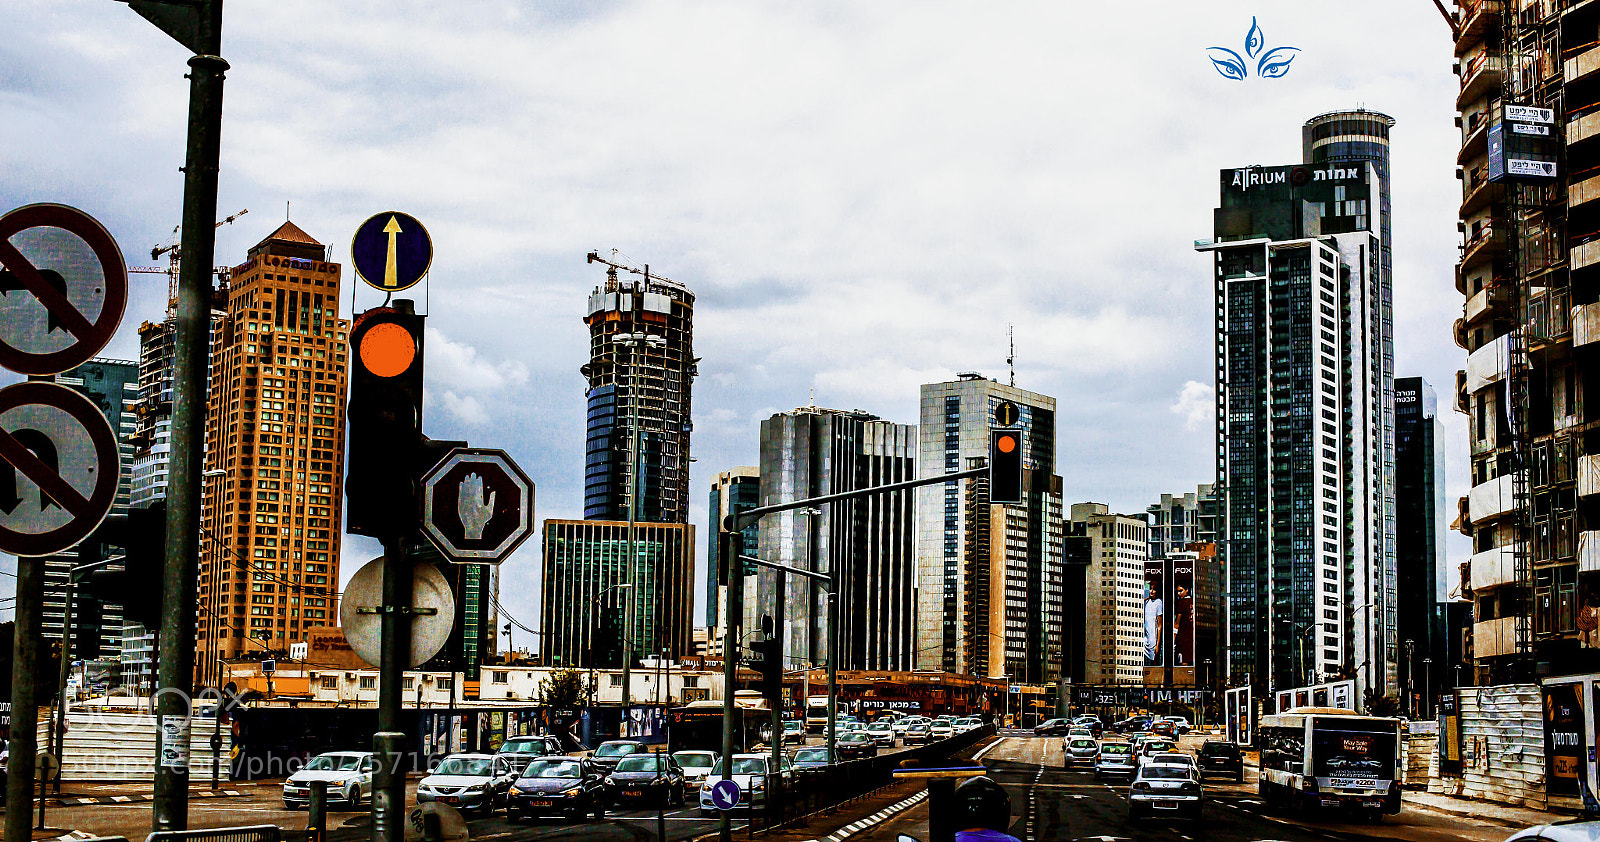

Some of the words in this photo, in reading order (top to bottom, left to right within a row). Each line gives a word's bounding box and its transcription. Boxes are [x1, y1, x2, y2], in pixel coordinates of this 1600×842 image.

[1232, 168, 1286, 191] ATRIUM
[1313, 168, 1358, 181] אמות
[263, 254, 338, 275] Leonardo
[888, 701, 909, 710] מכאן
